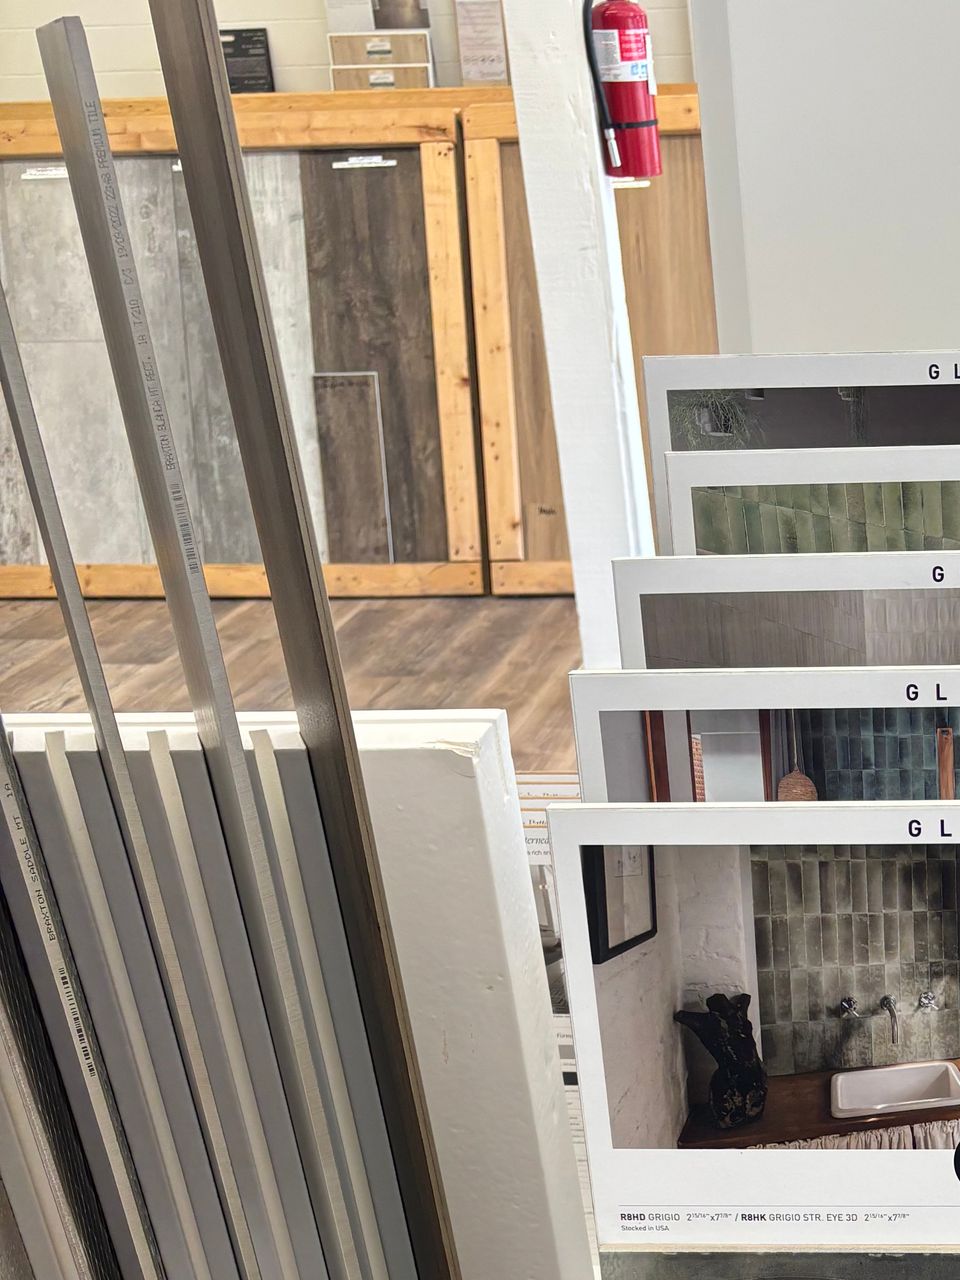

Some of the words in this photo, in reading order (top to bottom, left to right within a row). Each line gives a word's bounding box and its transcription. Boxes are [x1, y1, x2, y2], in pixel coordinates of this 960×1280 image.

[84, 100, 99, 123] TILE
[19, 837, 39, 883] SADDLE
[35, 889, 56, 942] BRAXTON
[620, 1213, 646, 1221] R8HD
[648, 1213, 680, 1221] GRIGIO
[741, 1213, 767, 1221] R8HK
[768, 1213, 801, 1222] GRIGIO
[803, 1213, 825, 1222] STR.
[827, 1213, 843, 1222] EYE
[845, 1213, 858, 1222] 3D
[621, 1224, 647, 1232] Stocked
[647, 1224, 654, 1232] in
